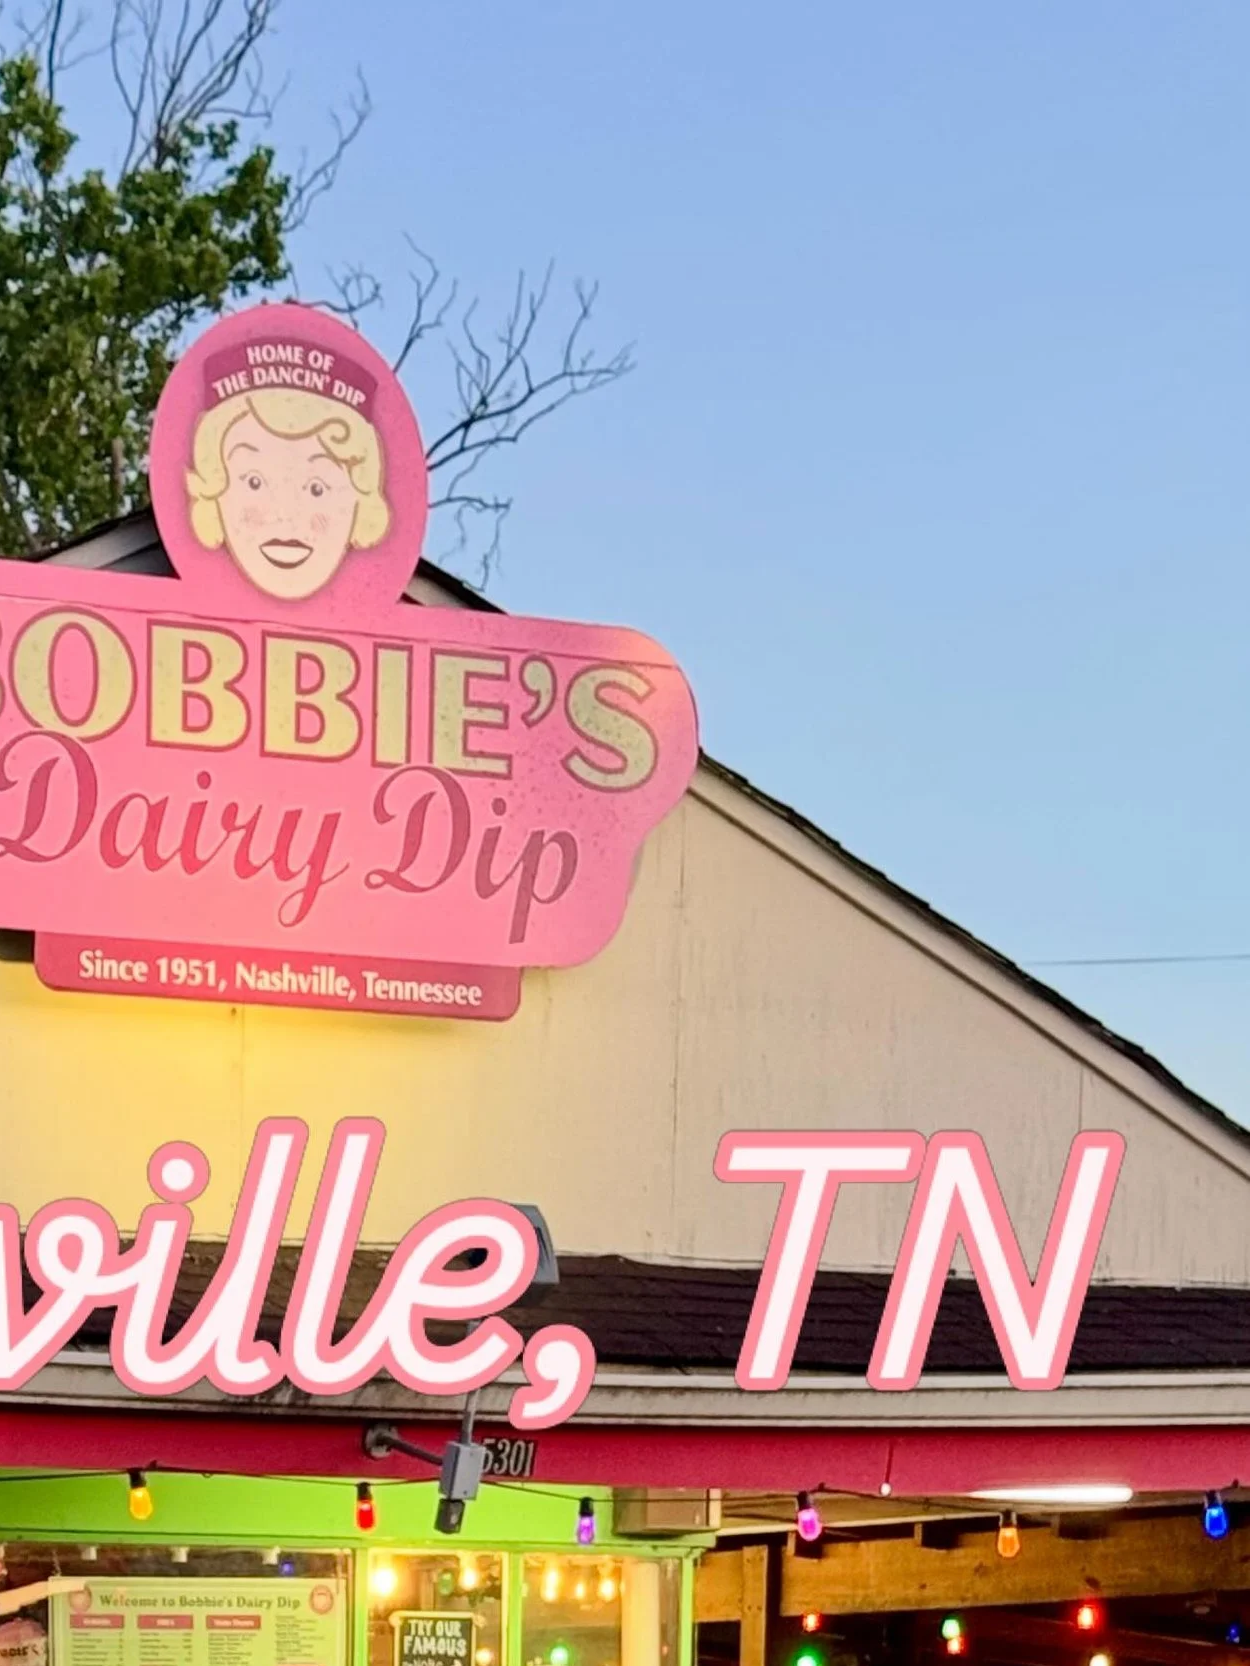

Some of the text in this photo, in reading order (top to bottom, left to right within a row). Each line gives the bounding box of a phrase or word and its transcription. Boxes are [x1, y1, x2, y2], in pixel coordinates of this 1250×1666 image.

[246, 344, 335, 372] HOME OF
[212, 365, 367, 406] THE DANCIN' DIP
[363, 764, 580, 945] Dip
[79, 949, 482, 1006] Since 1951, Nashville, Tennessee
[481, 1438, 534, 1477] 5301
[100, 1594, 301, 1610] Welcome to Bobbie's Dairy Dip
[408, 1619, 462, 1637] TRY OUR
[403, 1635, 467, 1657] FAMOUS
